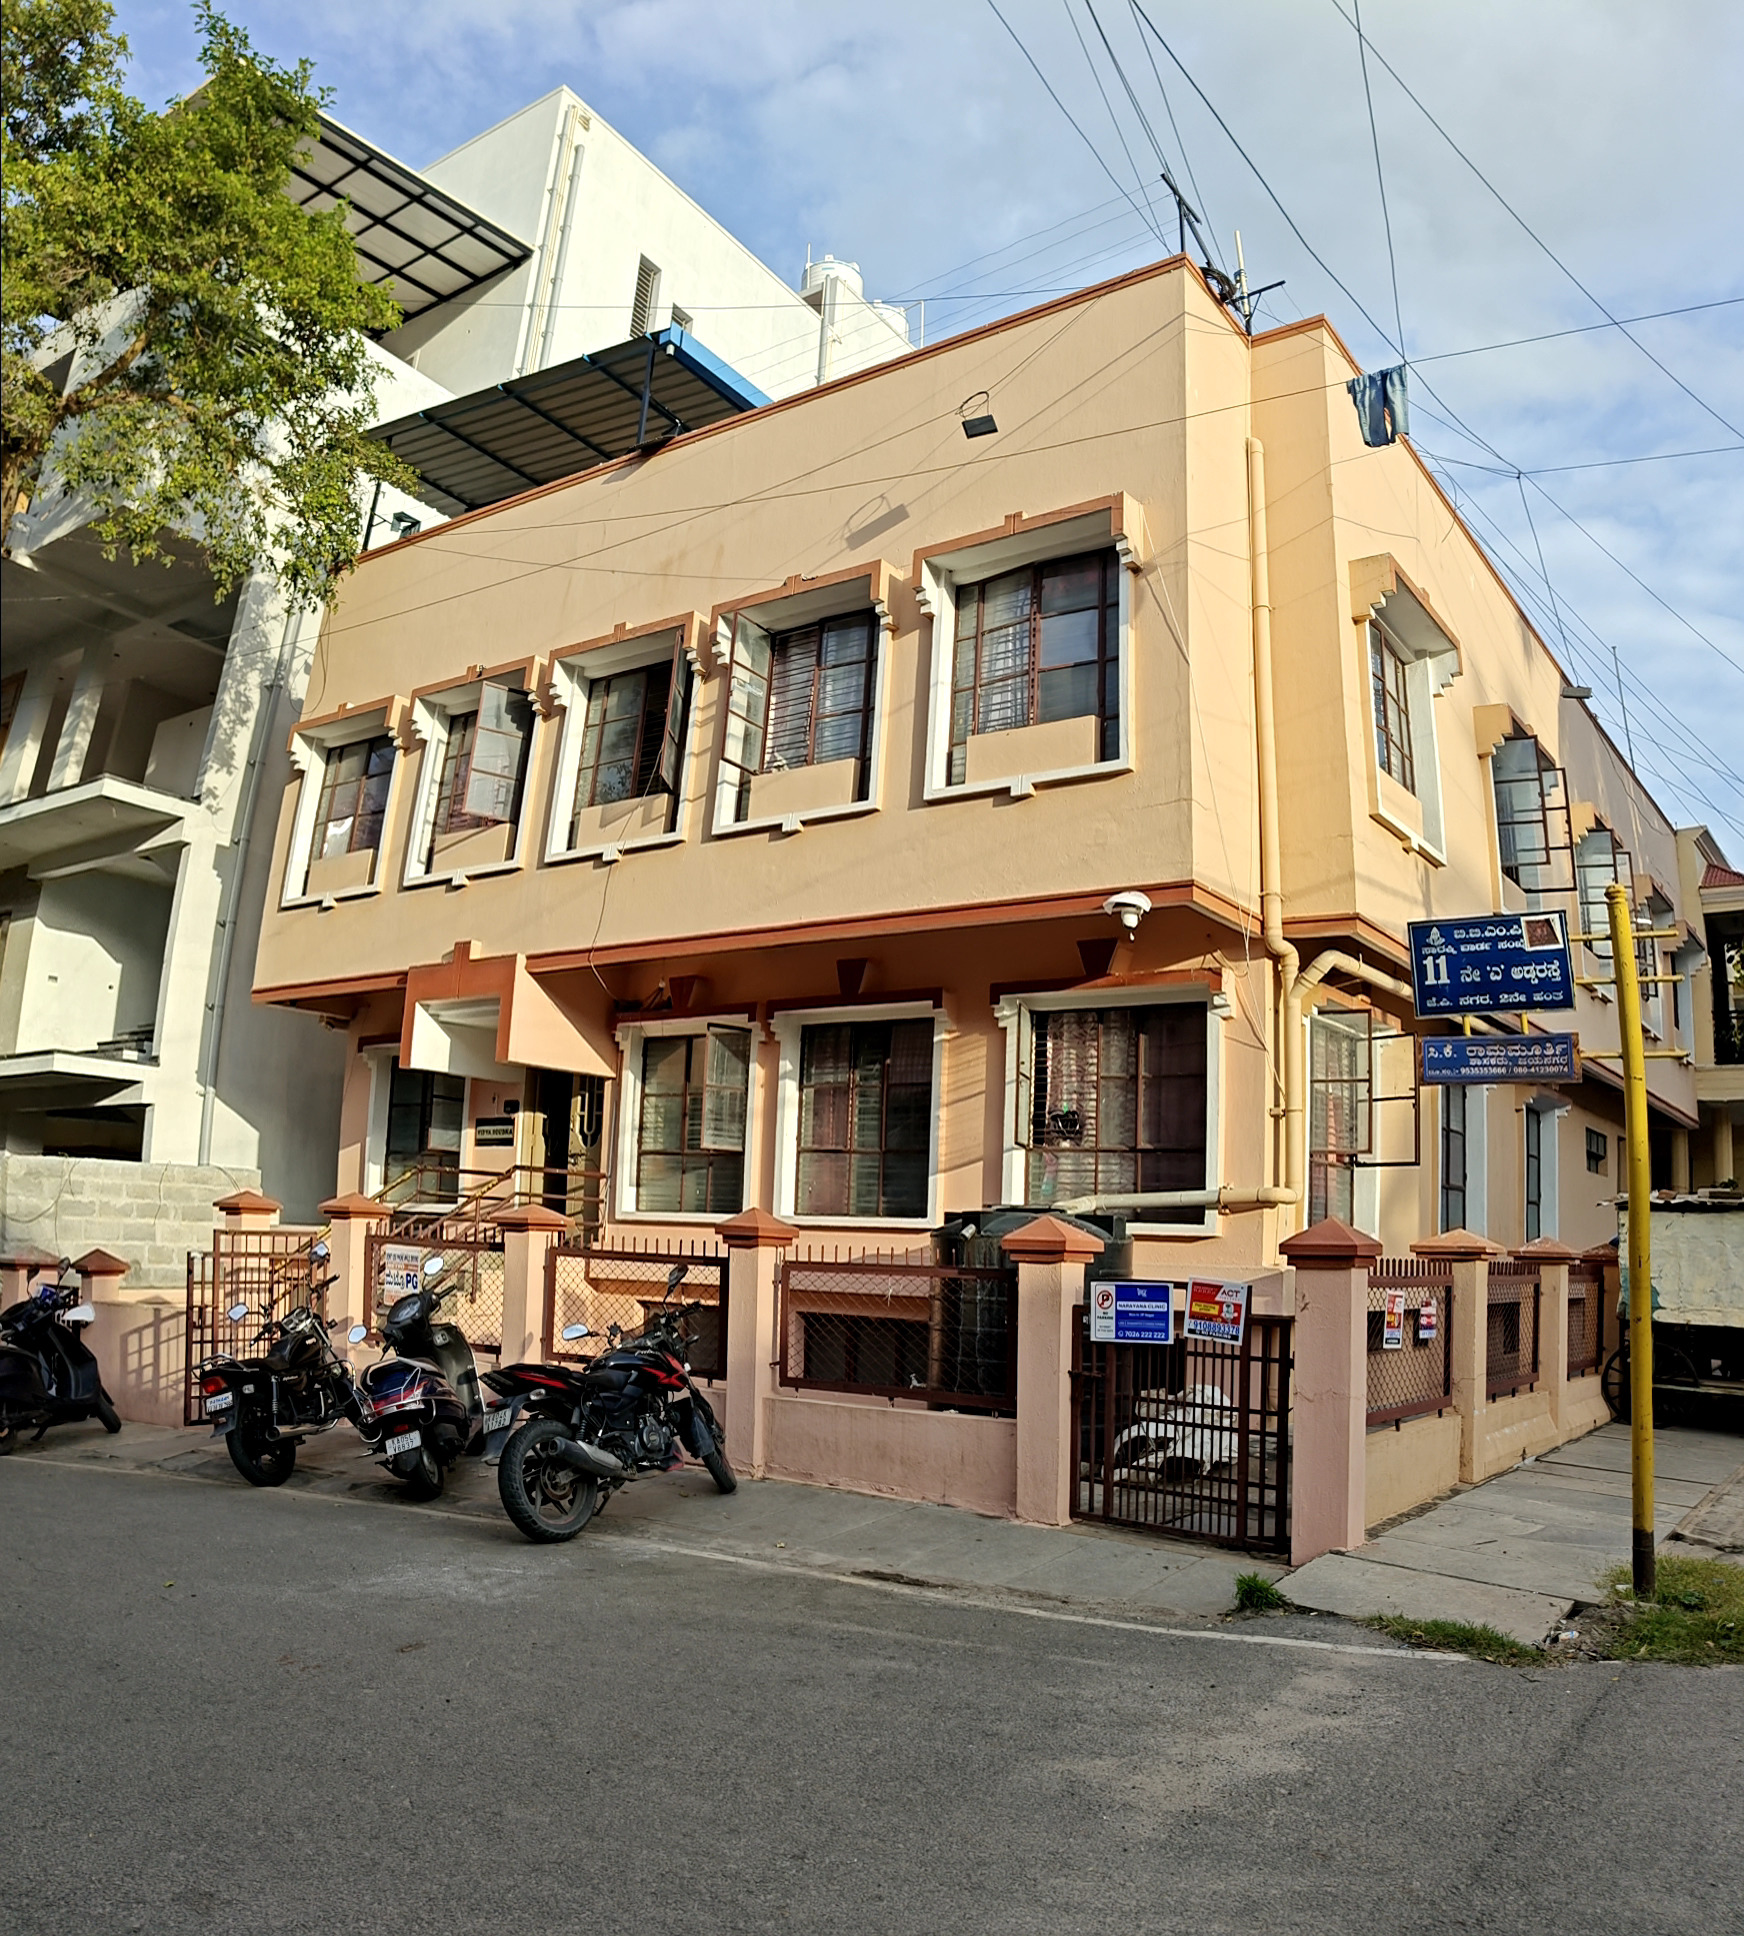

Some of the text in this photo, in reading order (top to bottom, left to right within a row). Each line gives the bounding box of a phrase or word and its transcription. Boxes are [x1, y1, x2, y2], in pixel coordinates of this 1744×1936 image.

[1423, 955, 1451, 985] 11
[1460, 965, 1481, 983] ನೇ
[1511, 960, 1562, 984] ಅಡ್ಡರಸ್ತೆ
[1533, 990, 1564, 1001] ಹಂತ
[1518, 1056, 1568, 1065] ಜಯನಗರ
[406, 1272, 418, 1290] PG
[1221, 1289, 1240, 1298] ACT
